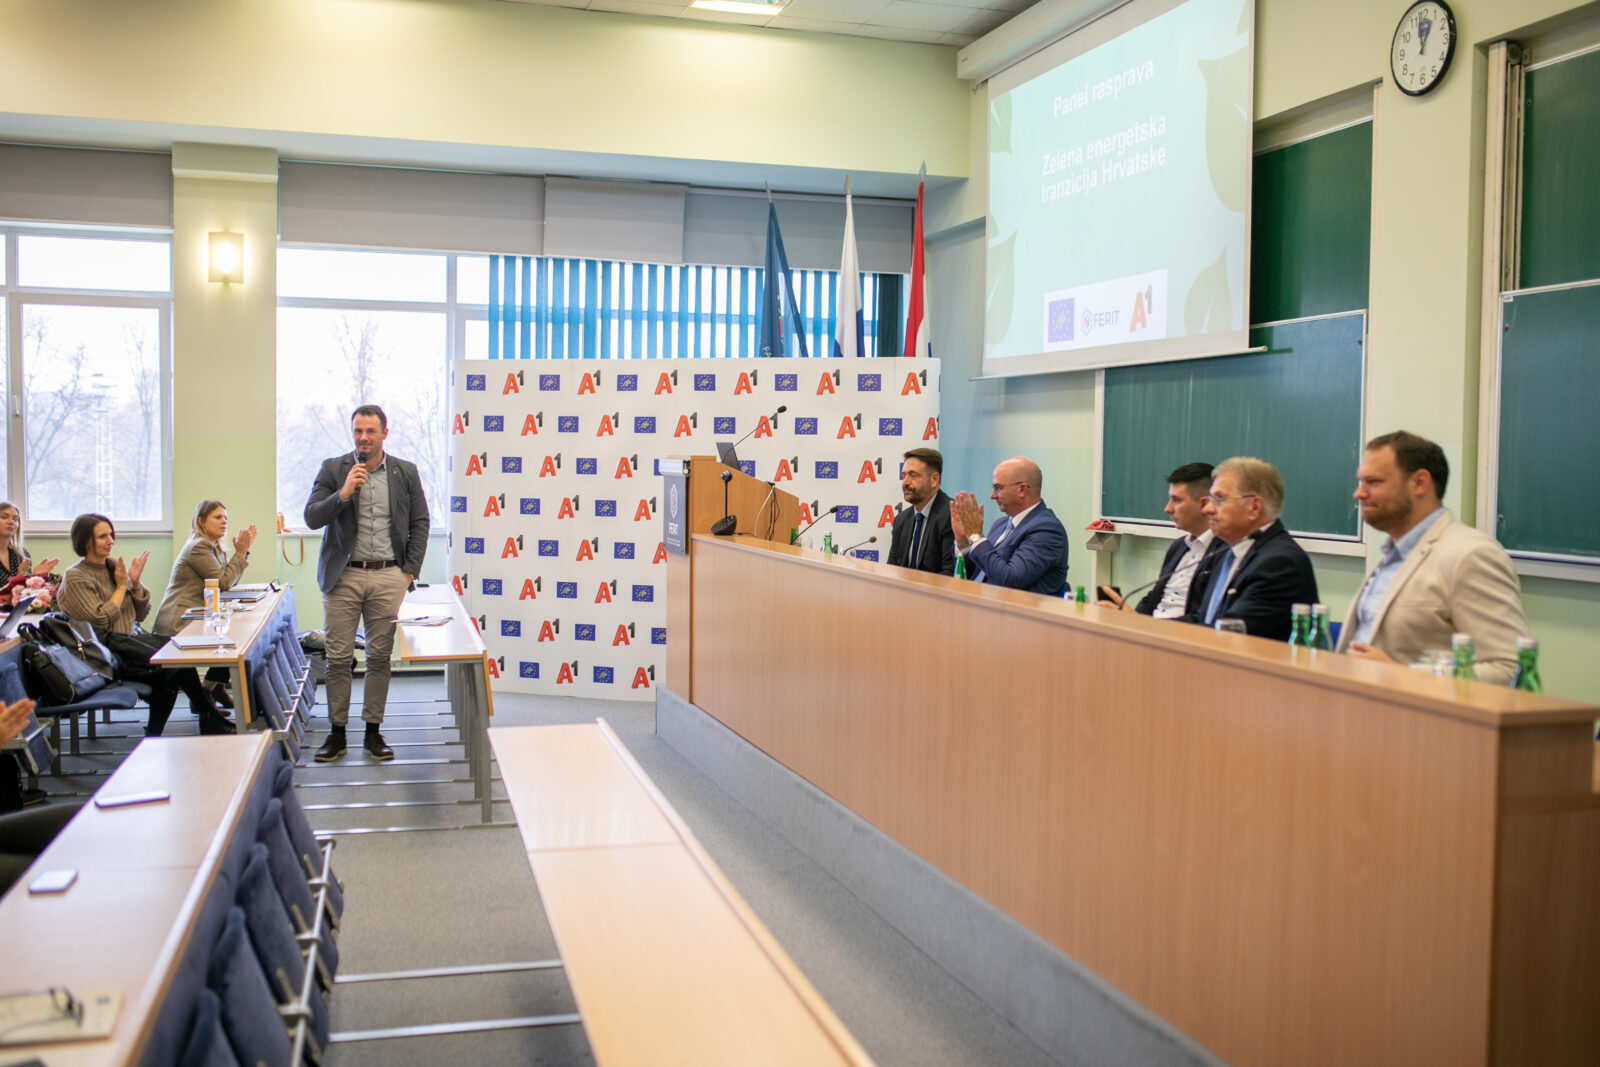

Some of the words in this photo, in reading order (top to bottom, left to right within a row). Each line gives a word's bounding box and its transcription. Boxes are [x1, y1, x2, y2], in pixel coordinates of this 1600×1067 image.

[1440, 18, 1446, 31] 2
[1401, 32, 1410, 44] 10
[1443, 33, 1448, 45] 3
[1400, 49, 1405, 61] 9
[1439, 50, 1446, 61] 4
[1402, 64, 1408, 76] 8
[1410, 73, 1415, 85] 7
[1420, 73, 1426, 85] 6
[1431, 66, 1437, 78] 5
[1053, 84, 1088, 119] Panel
[1092, 59, 1154, 103] rasprava
[1041, 146, 1083, 177] Zelena
[1086, 115, 1166, 160] energetska
[1041, 168, 1098, 204] tranzicija
[1102, 145, 1166, 184] Hrvatske
[1093, 310, 1120, 327] FERIT
[1129, 284, 1153, 333] A1
[503, 370, 523, 395] A1
[578, 370, 600, 395] A1
[655, 369, 677, 395] A1
[734, 369, 757, 395] A1
[817, 369, 840, 395] A1
[902, 369, 926, 396] A1
[453, 411, 469, 435] A1
[521, 411, 543, 436] A1
[597, 412, 619, 437] A1
[674, 412, 697, 437] A1
[755, 412, 778, 438] A1
[837, 412, 862, 439] A1
[466, 452, 487, 476] A1
[539, 453, 561, 477] A1
[615, 454, 638, 479] A1
[774, 456, 798, 482] A1
[858, 457, 882, 483] A1
[484, 493, 505, 517] A1
[558, 495, 579, 519] A1
[634, 496, 656, 521] A1
[502, 534, 523, 558] A1
[576, 537, 598, 561] A1
[653, 541, 668, 564] A
[452, 573, 468, 596] A1
[520, 576, 541, 600] A1
[595, 579, 617, 603] A1
[538, 618, 559, 642] A1
[613, 621, 635, 646] A1
[557, 660, 578, 684] A1
[632, 664, 654, 688] A1
